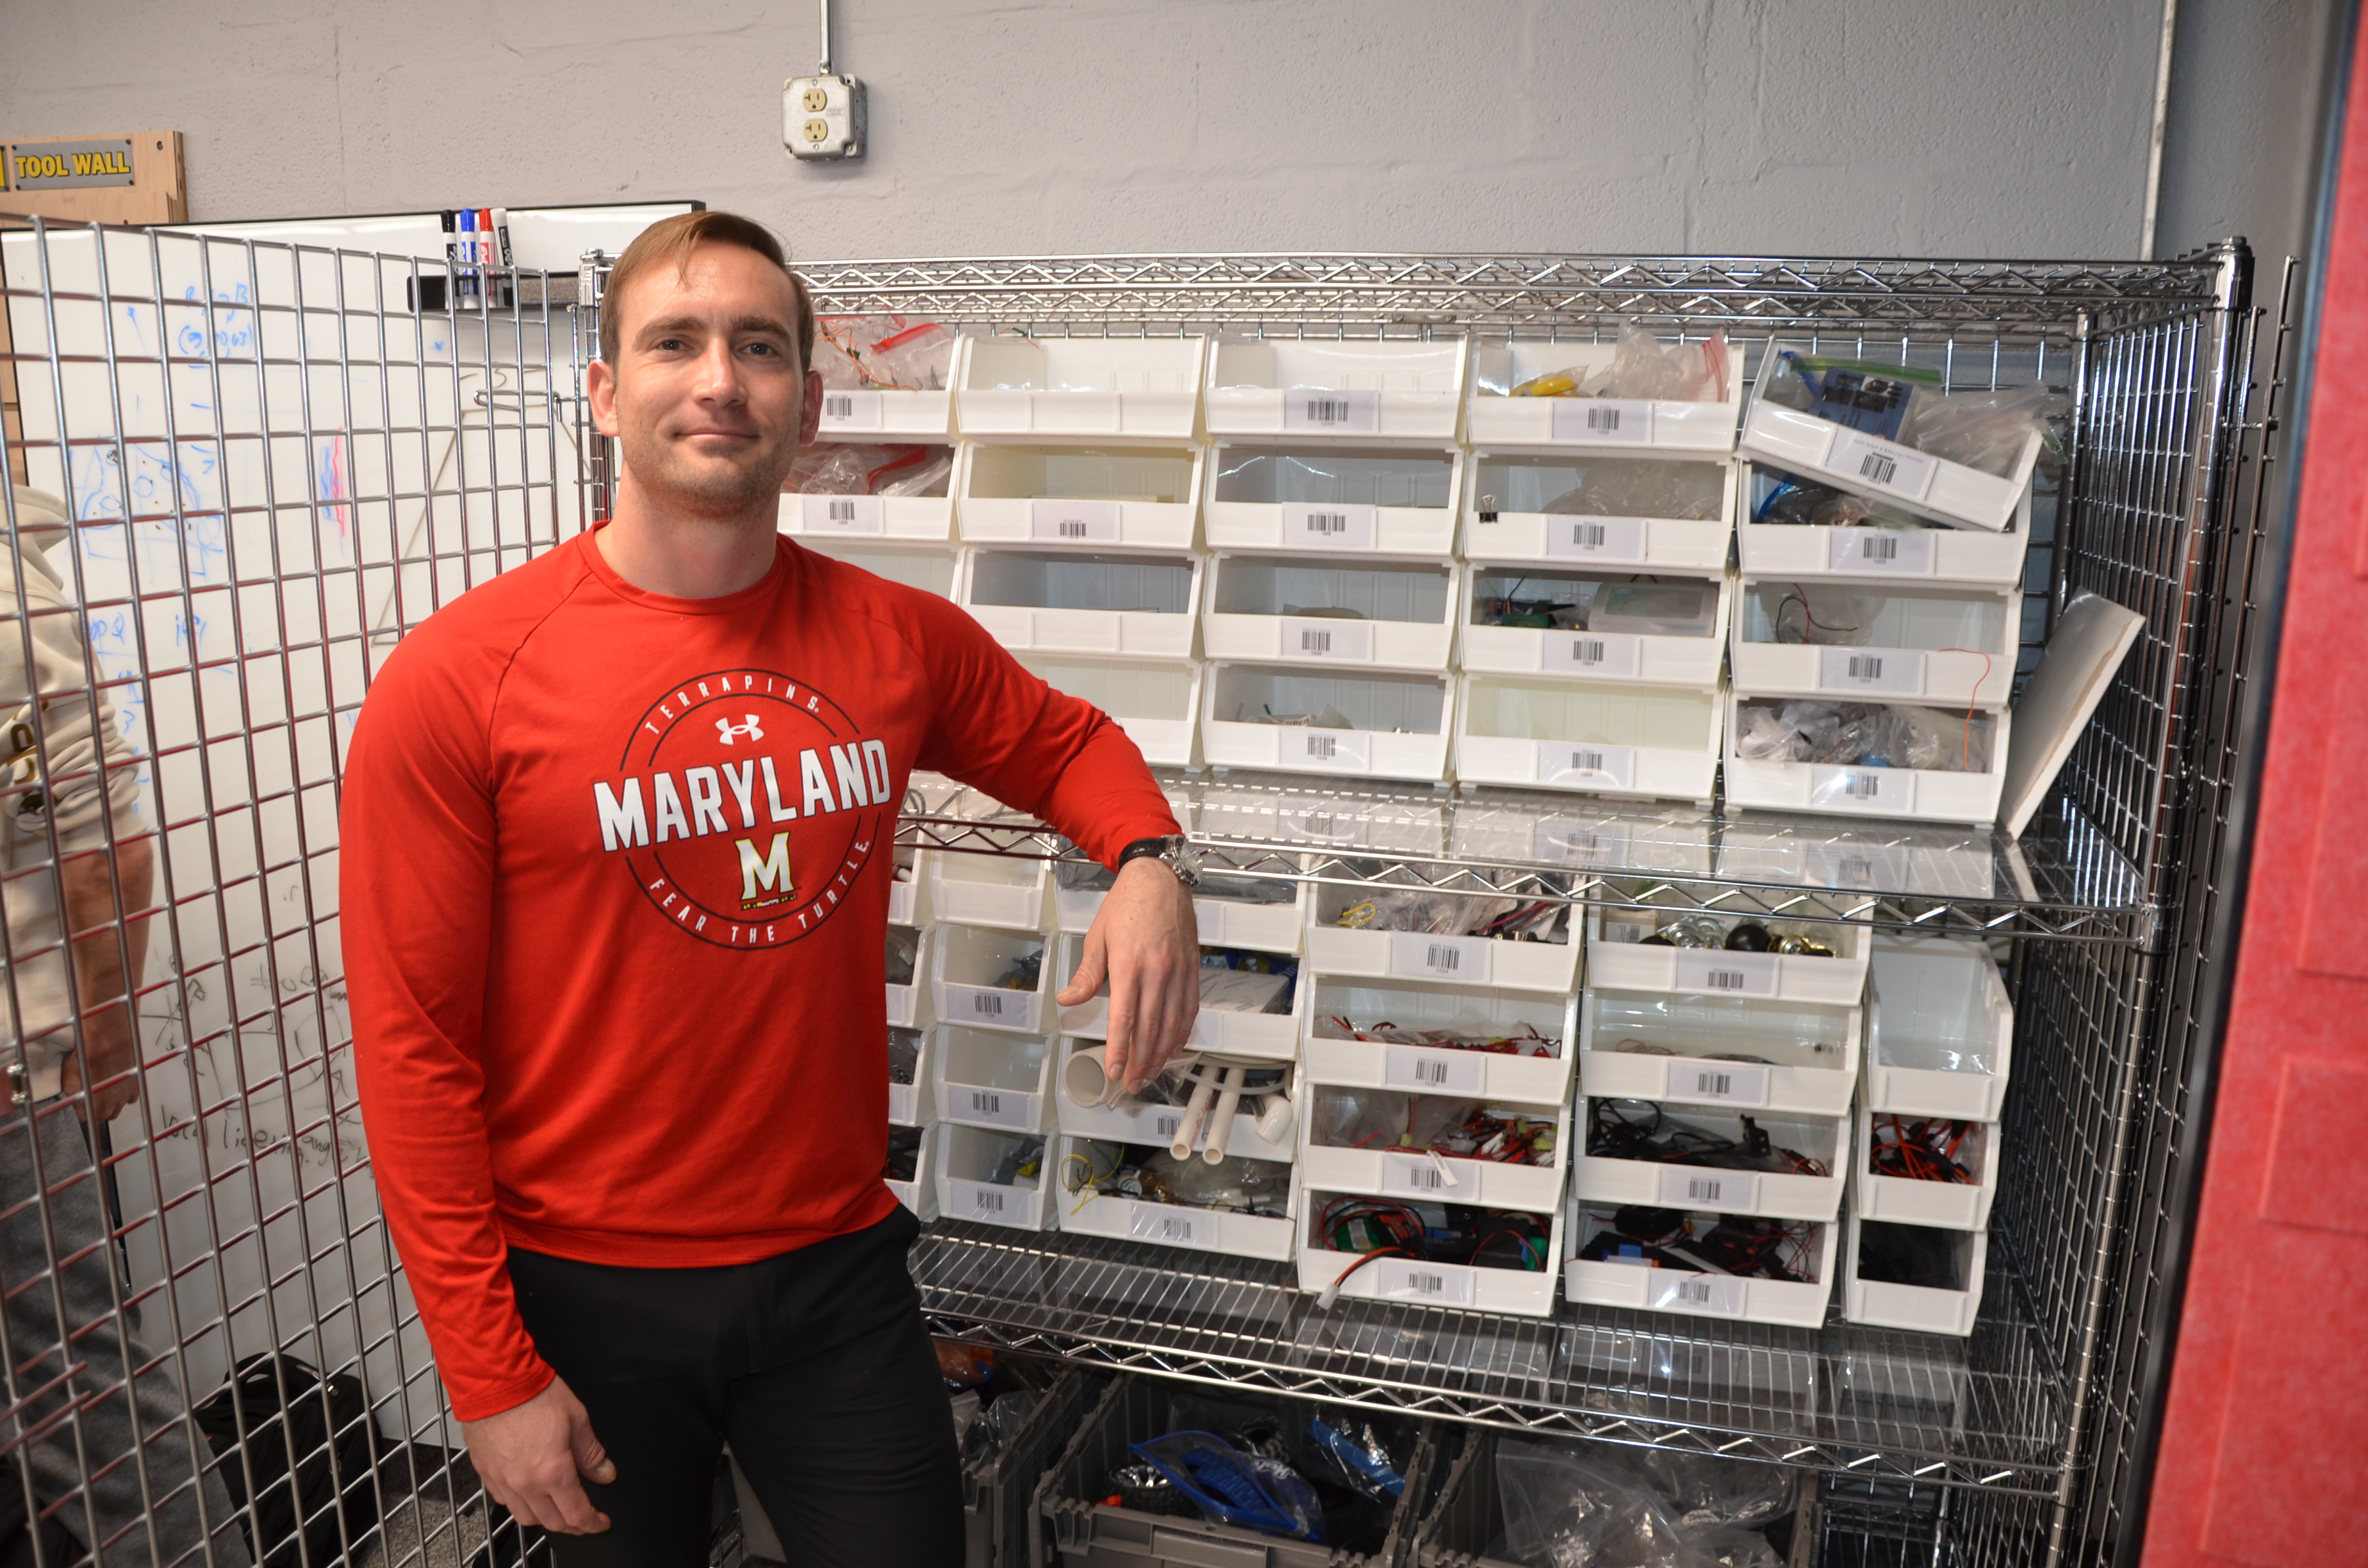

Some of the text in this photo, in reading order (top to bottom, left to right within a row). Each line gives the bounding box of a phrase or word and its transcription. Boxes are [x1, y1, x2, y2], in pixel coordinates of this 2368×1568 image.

[15, 154, 70, 178] TOOL
[72, 152, 131, 175] WALL
[593, 739, 892, 853] MARYLAND
[648, 840, 869, 944] FEAR THE TURTLE
[734, 831, 795, 901] M
